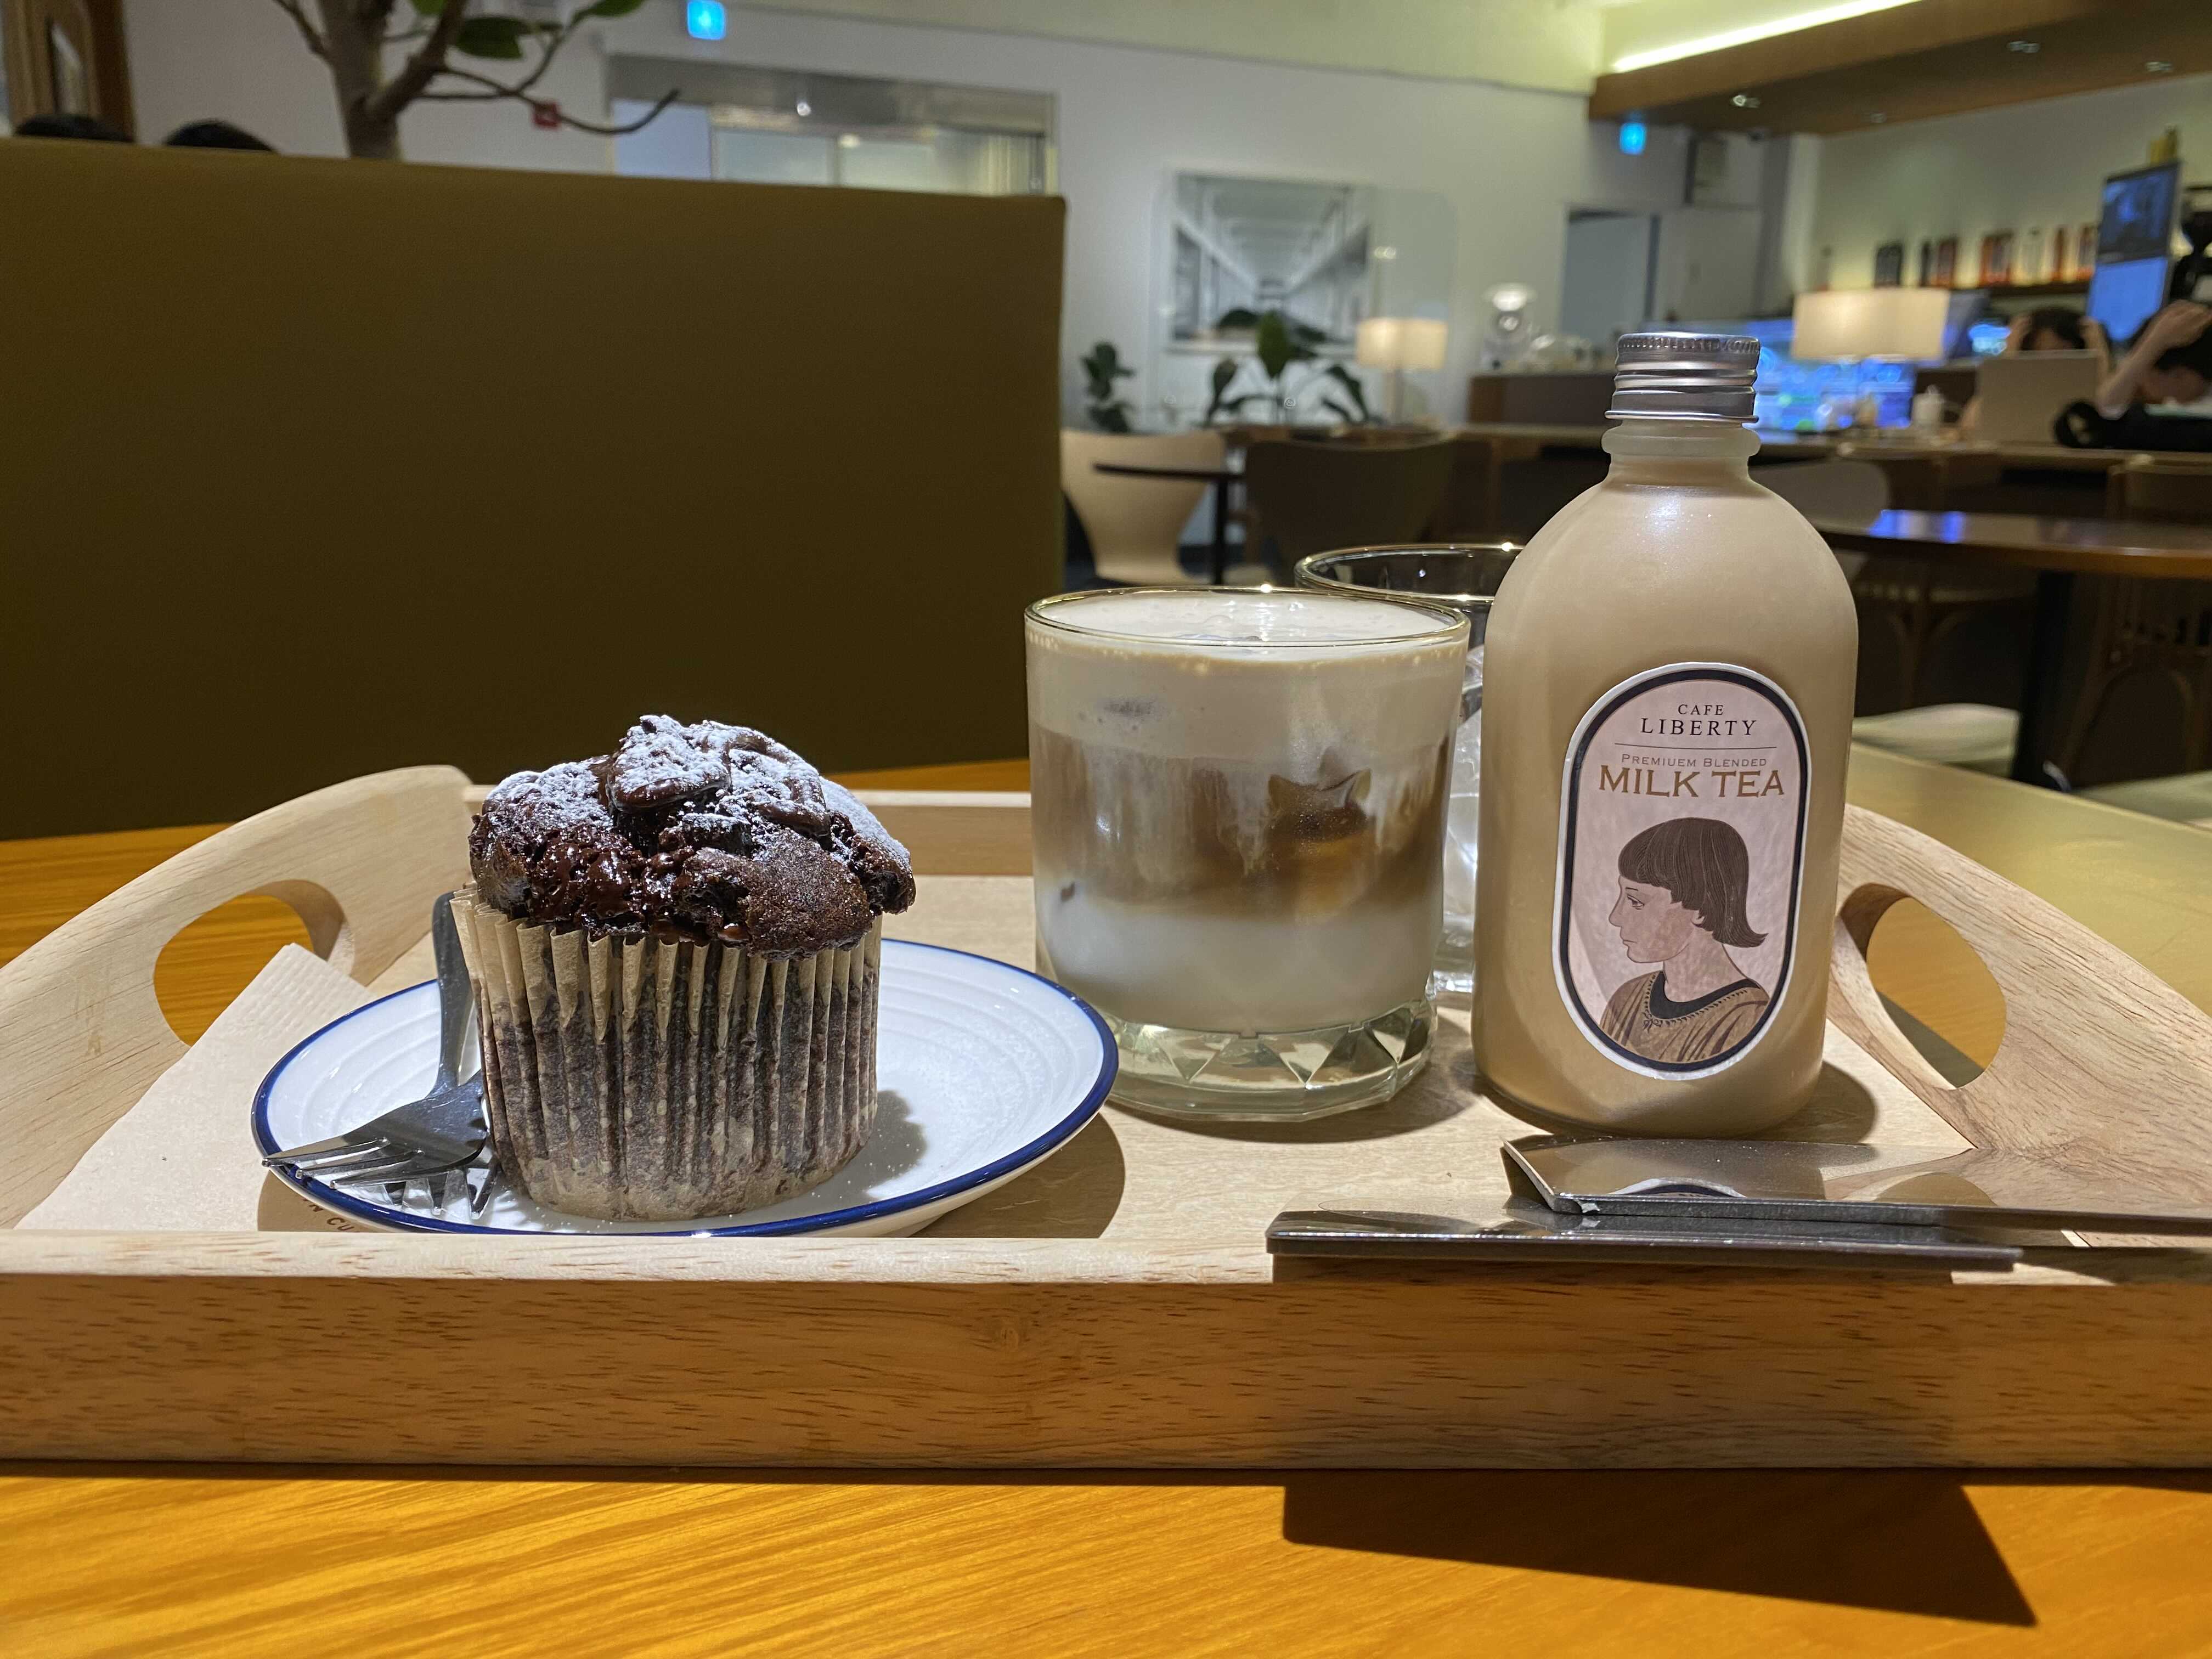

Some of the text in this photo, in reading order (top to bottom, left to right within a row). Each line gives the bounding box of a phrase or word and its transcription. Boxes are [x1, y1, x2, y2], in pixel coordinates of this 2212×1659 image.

[1678, 704, 1724, 715] CAFE
[1640, 718, 1757, 736] LIBERTY
[1703, 758, 1767, 767] BLENDED
[1599, 765, 1785, 798] MILK TEA
